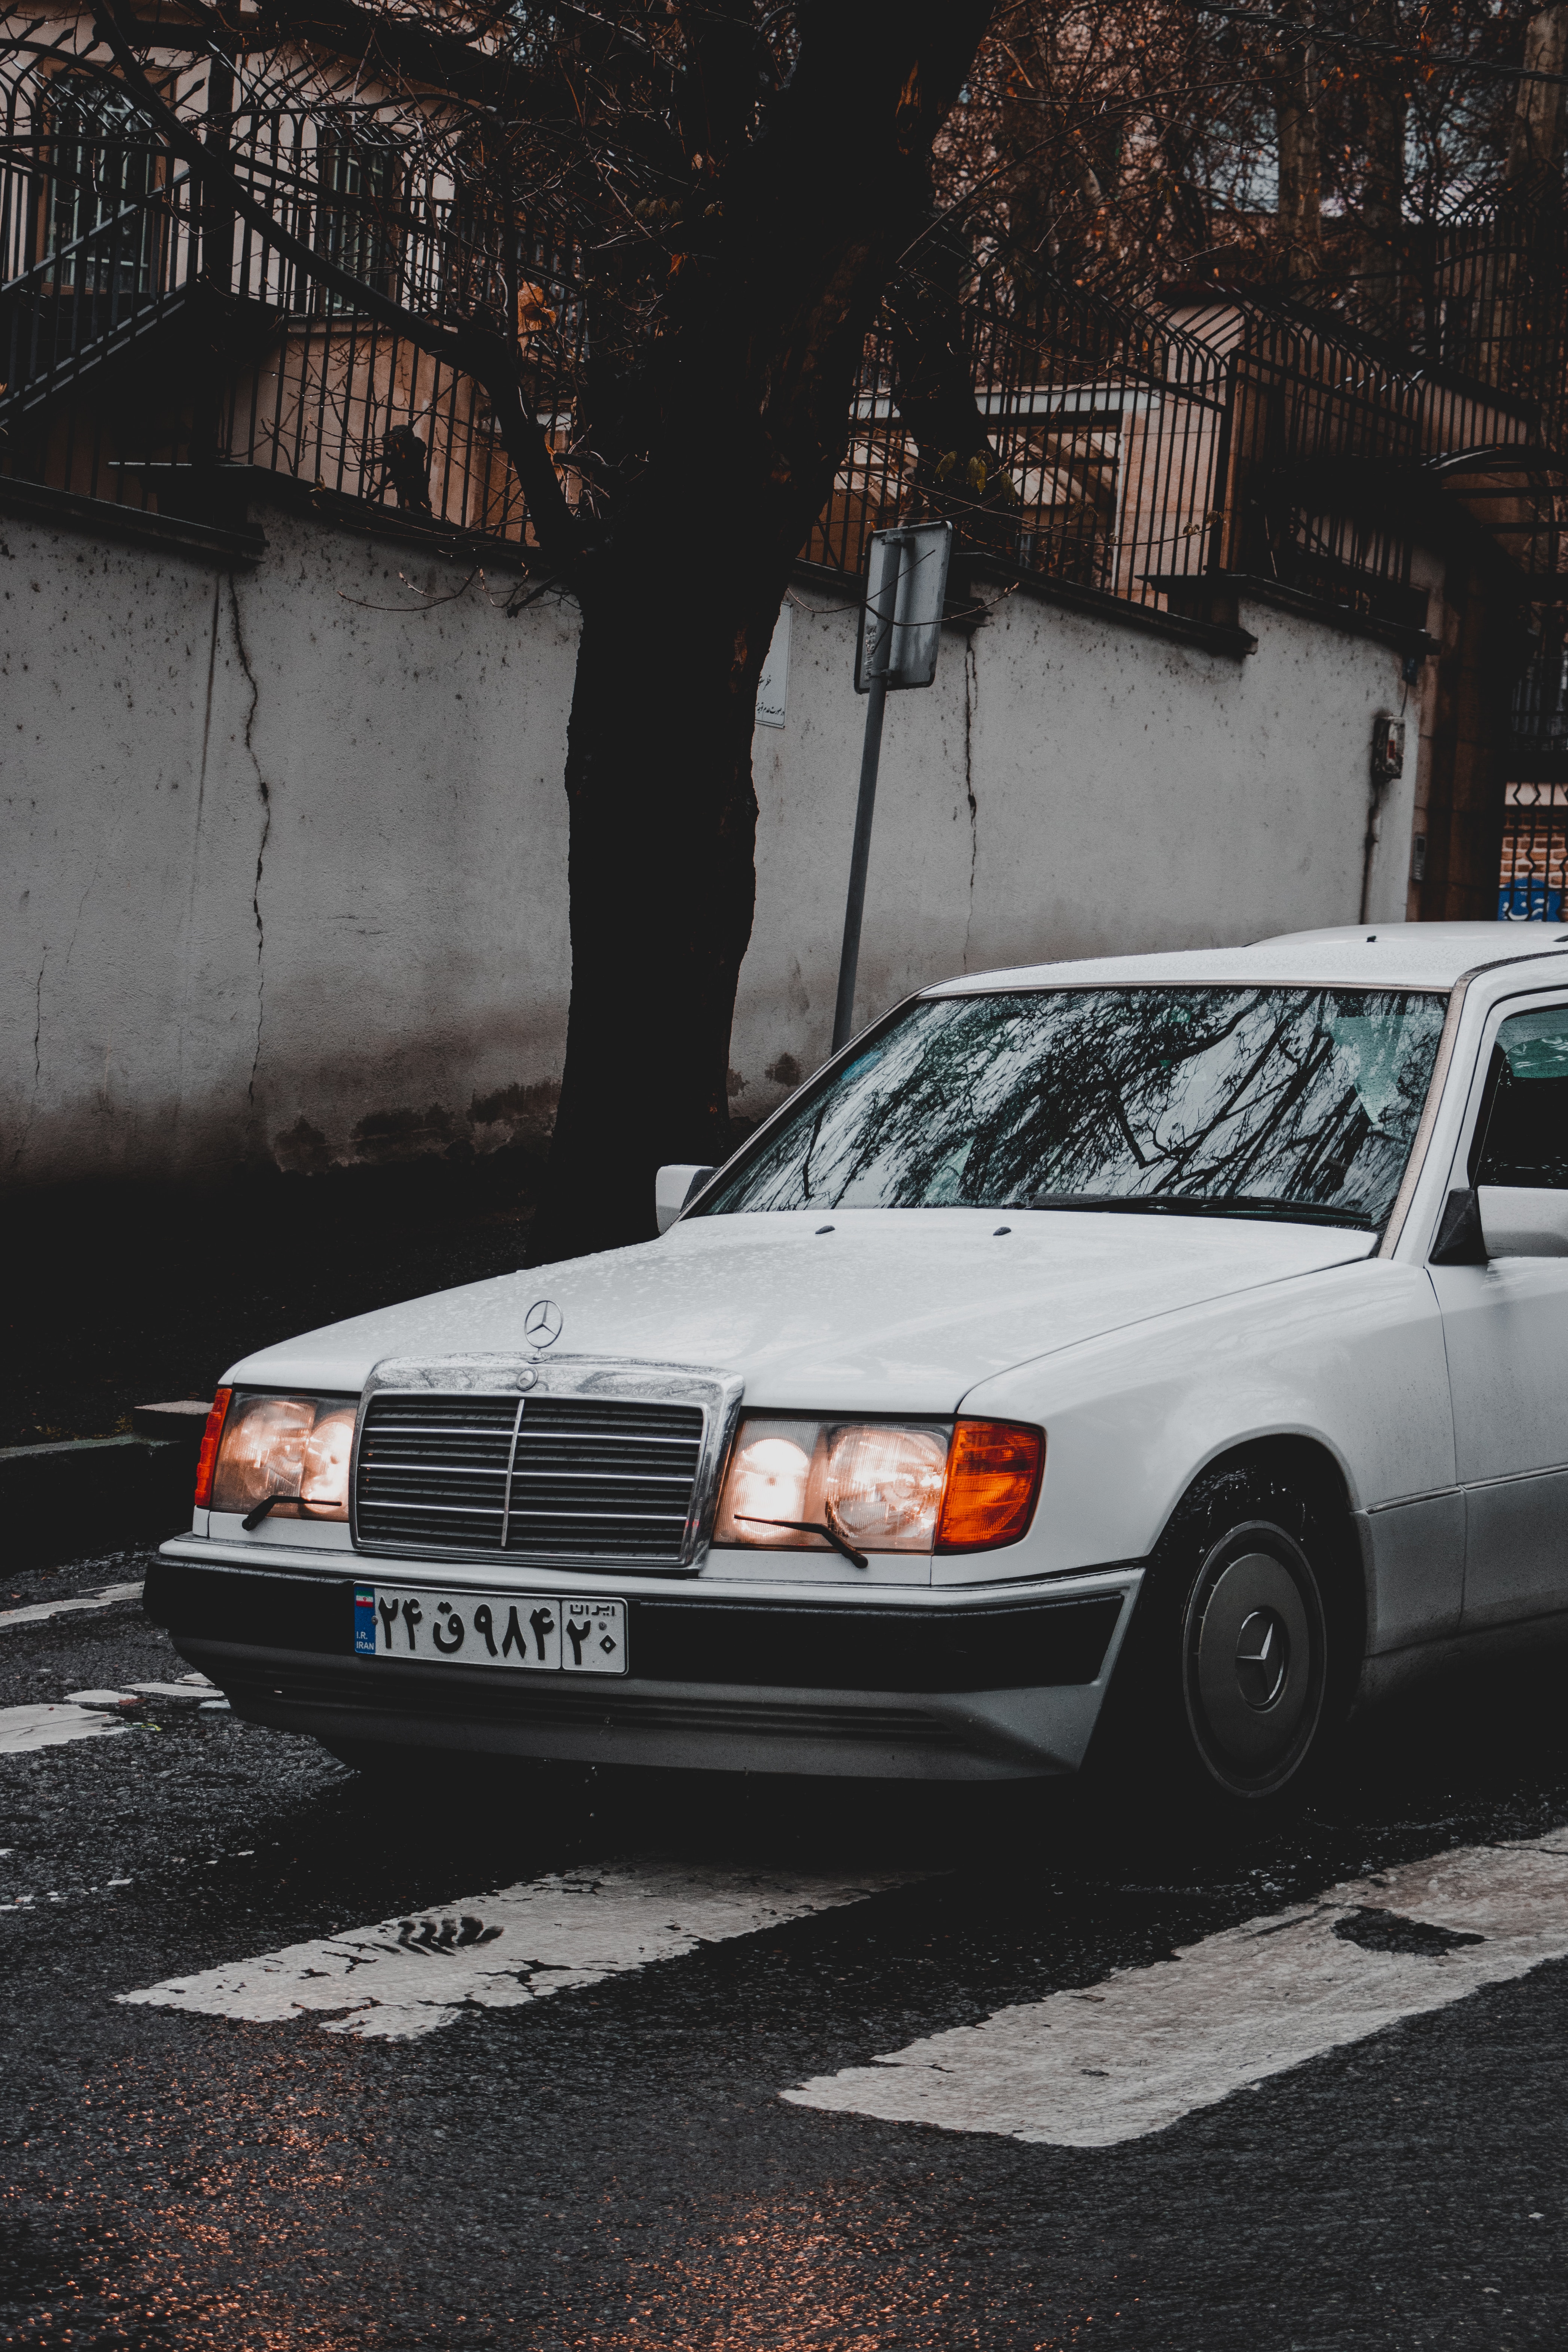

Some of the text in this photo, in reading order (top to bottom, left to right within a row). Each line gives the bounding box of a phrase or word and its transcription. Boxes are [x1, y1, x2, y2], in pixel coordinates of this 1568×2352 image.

[570, 1604, 615, 1616] ایران
[356, 1631, 368, 1640] I.R.
[356, 1641, 374, 1650] IRAN
[566, 1619, 616, 1665] ۲۰
